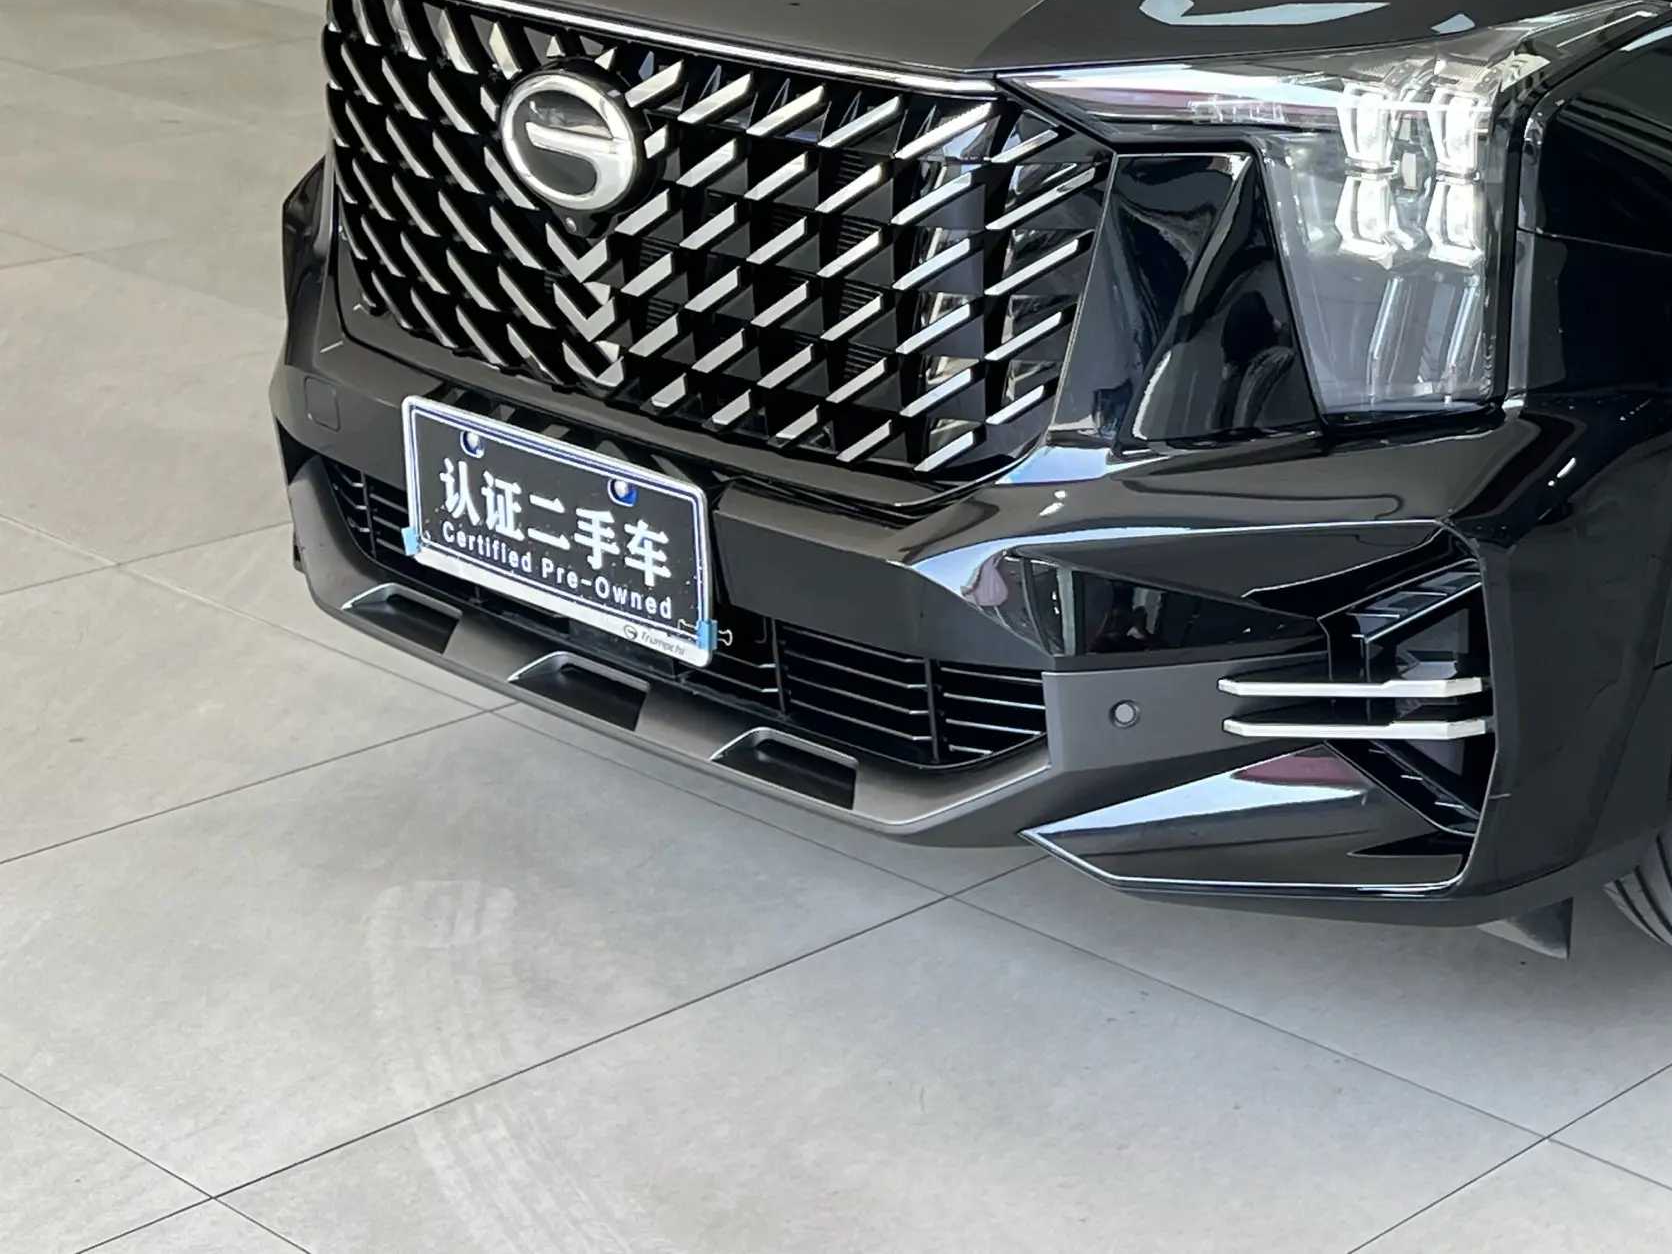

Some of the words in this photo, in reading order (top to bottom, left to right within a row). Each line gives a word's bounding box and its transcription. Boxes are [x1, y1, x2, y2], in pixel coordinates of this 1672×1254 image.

[439, 457, 672, 588] 认证二手车
[442, 520, 533, 574] Certified
[541, 557, 673, 620] Pre-Owned
